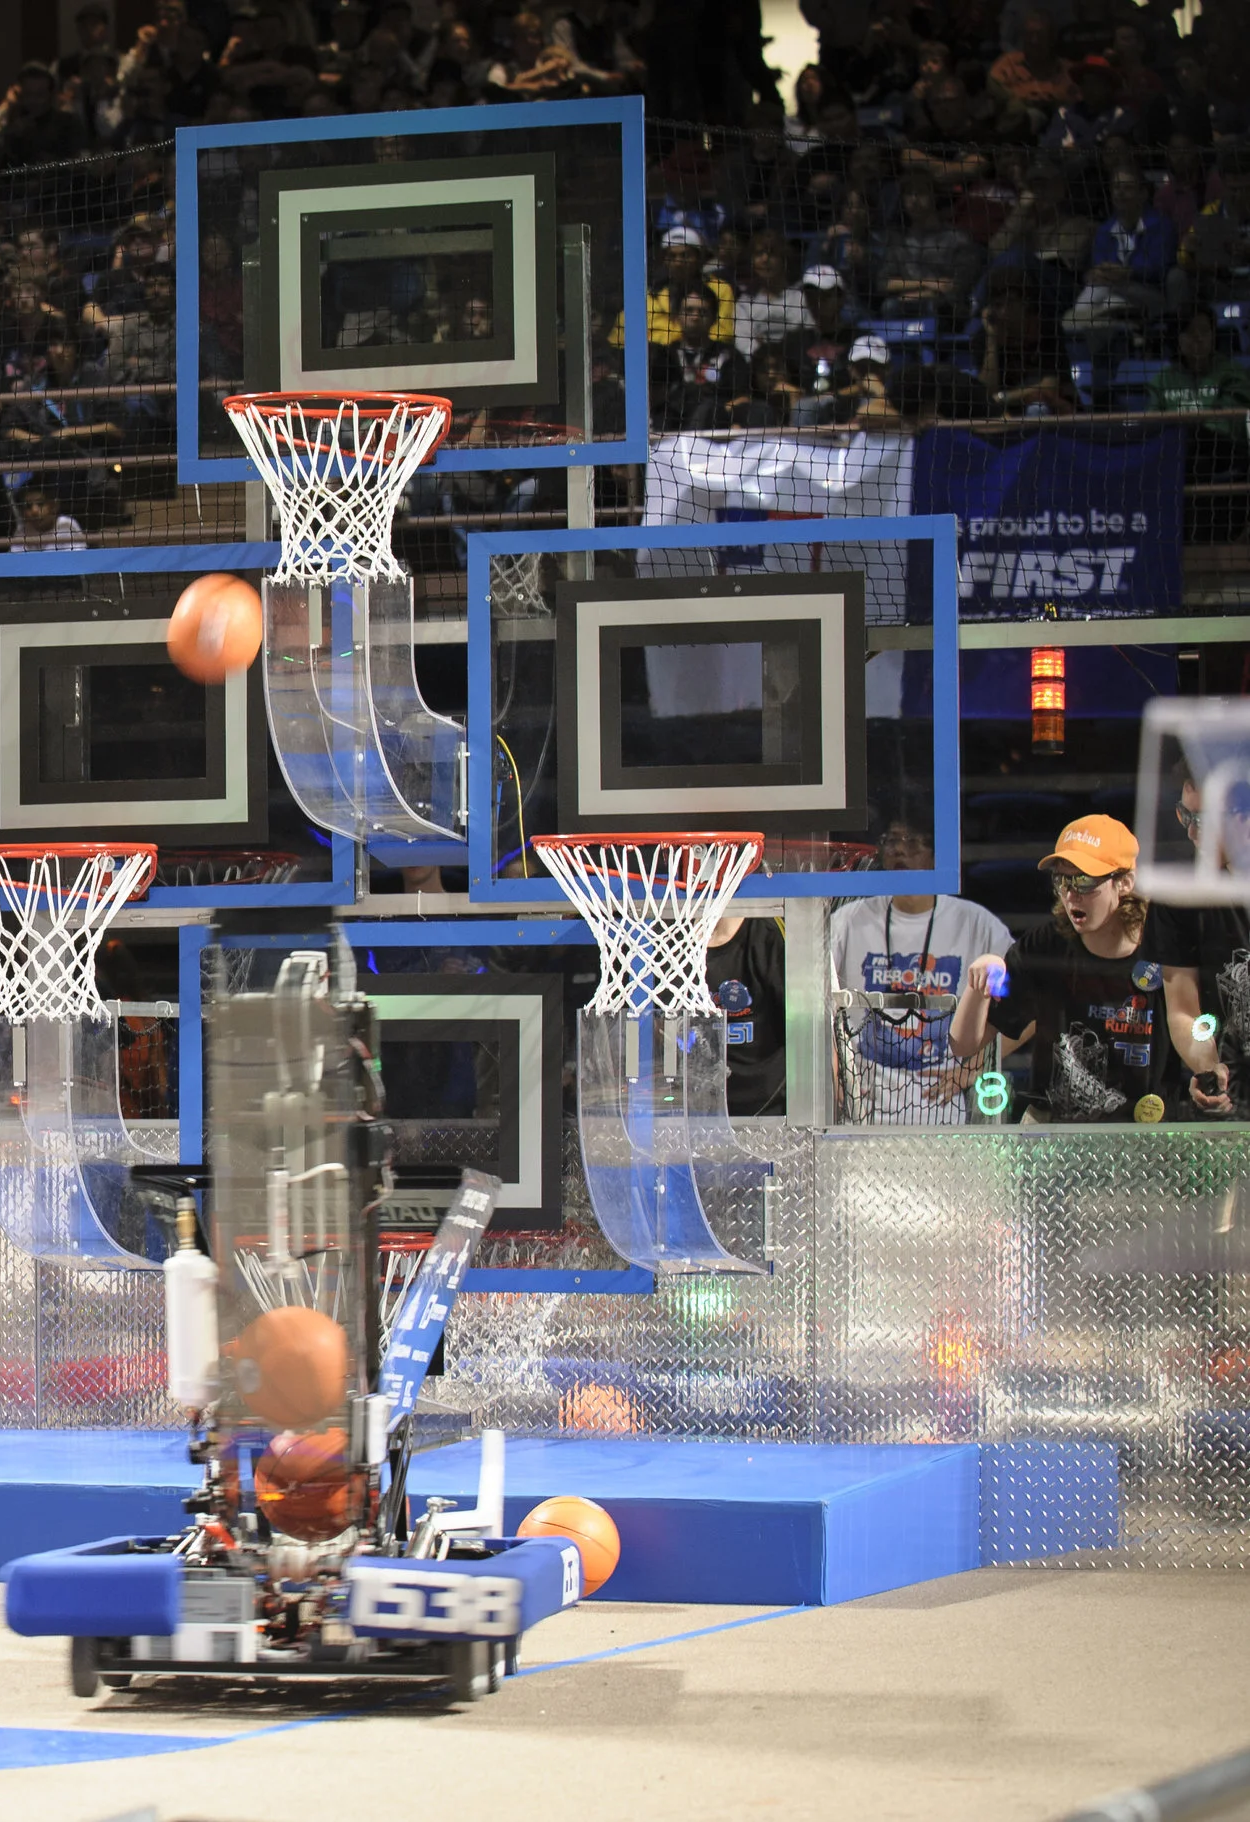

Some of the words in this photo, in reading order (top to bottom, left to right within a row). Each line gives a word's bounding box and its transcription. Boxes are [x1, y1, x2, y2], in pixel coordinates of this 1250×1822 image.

[969, 510, 1050, 541] proud
[1056, 511, 1084, 535] to
[1091, 508, 1125, 534] be
[1131, 512, 1147, 532] a
[957, 546, 1136, 599] FIRST
[1113, 1041, 1151, 1068] 75
